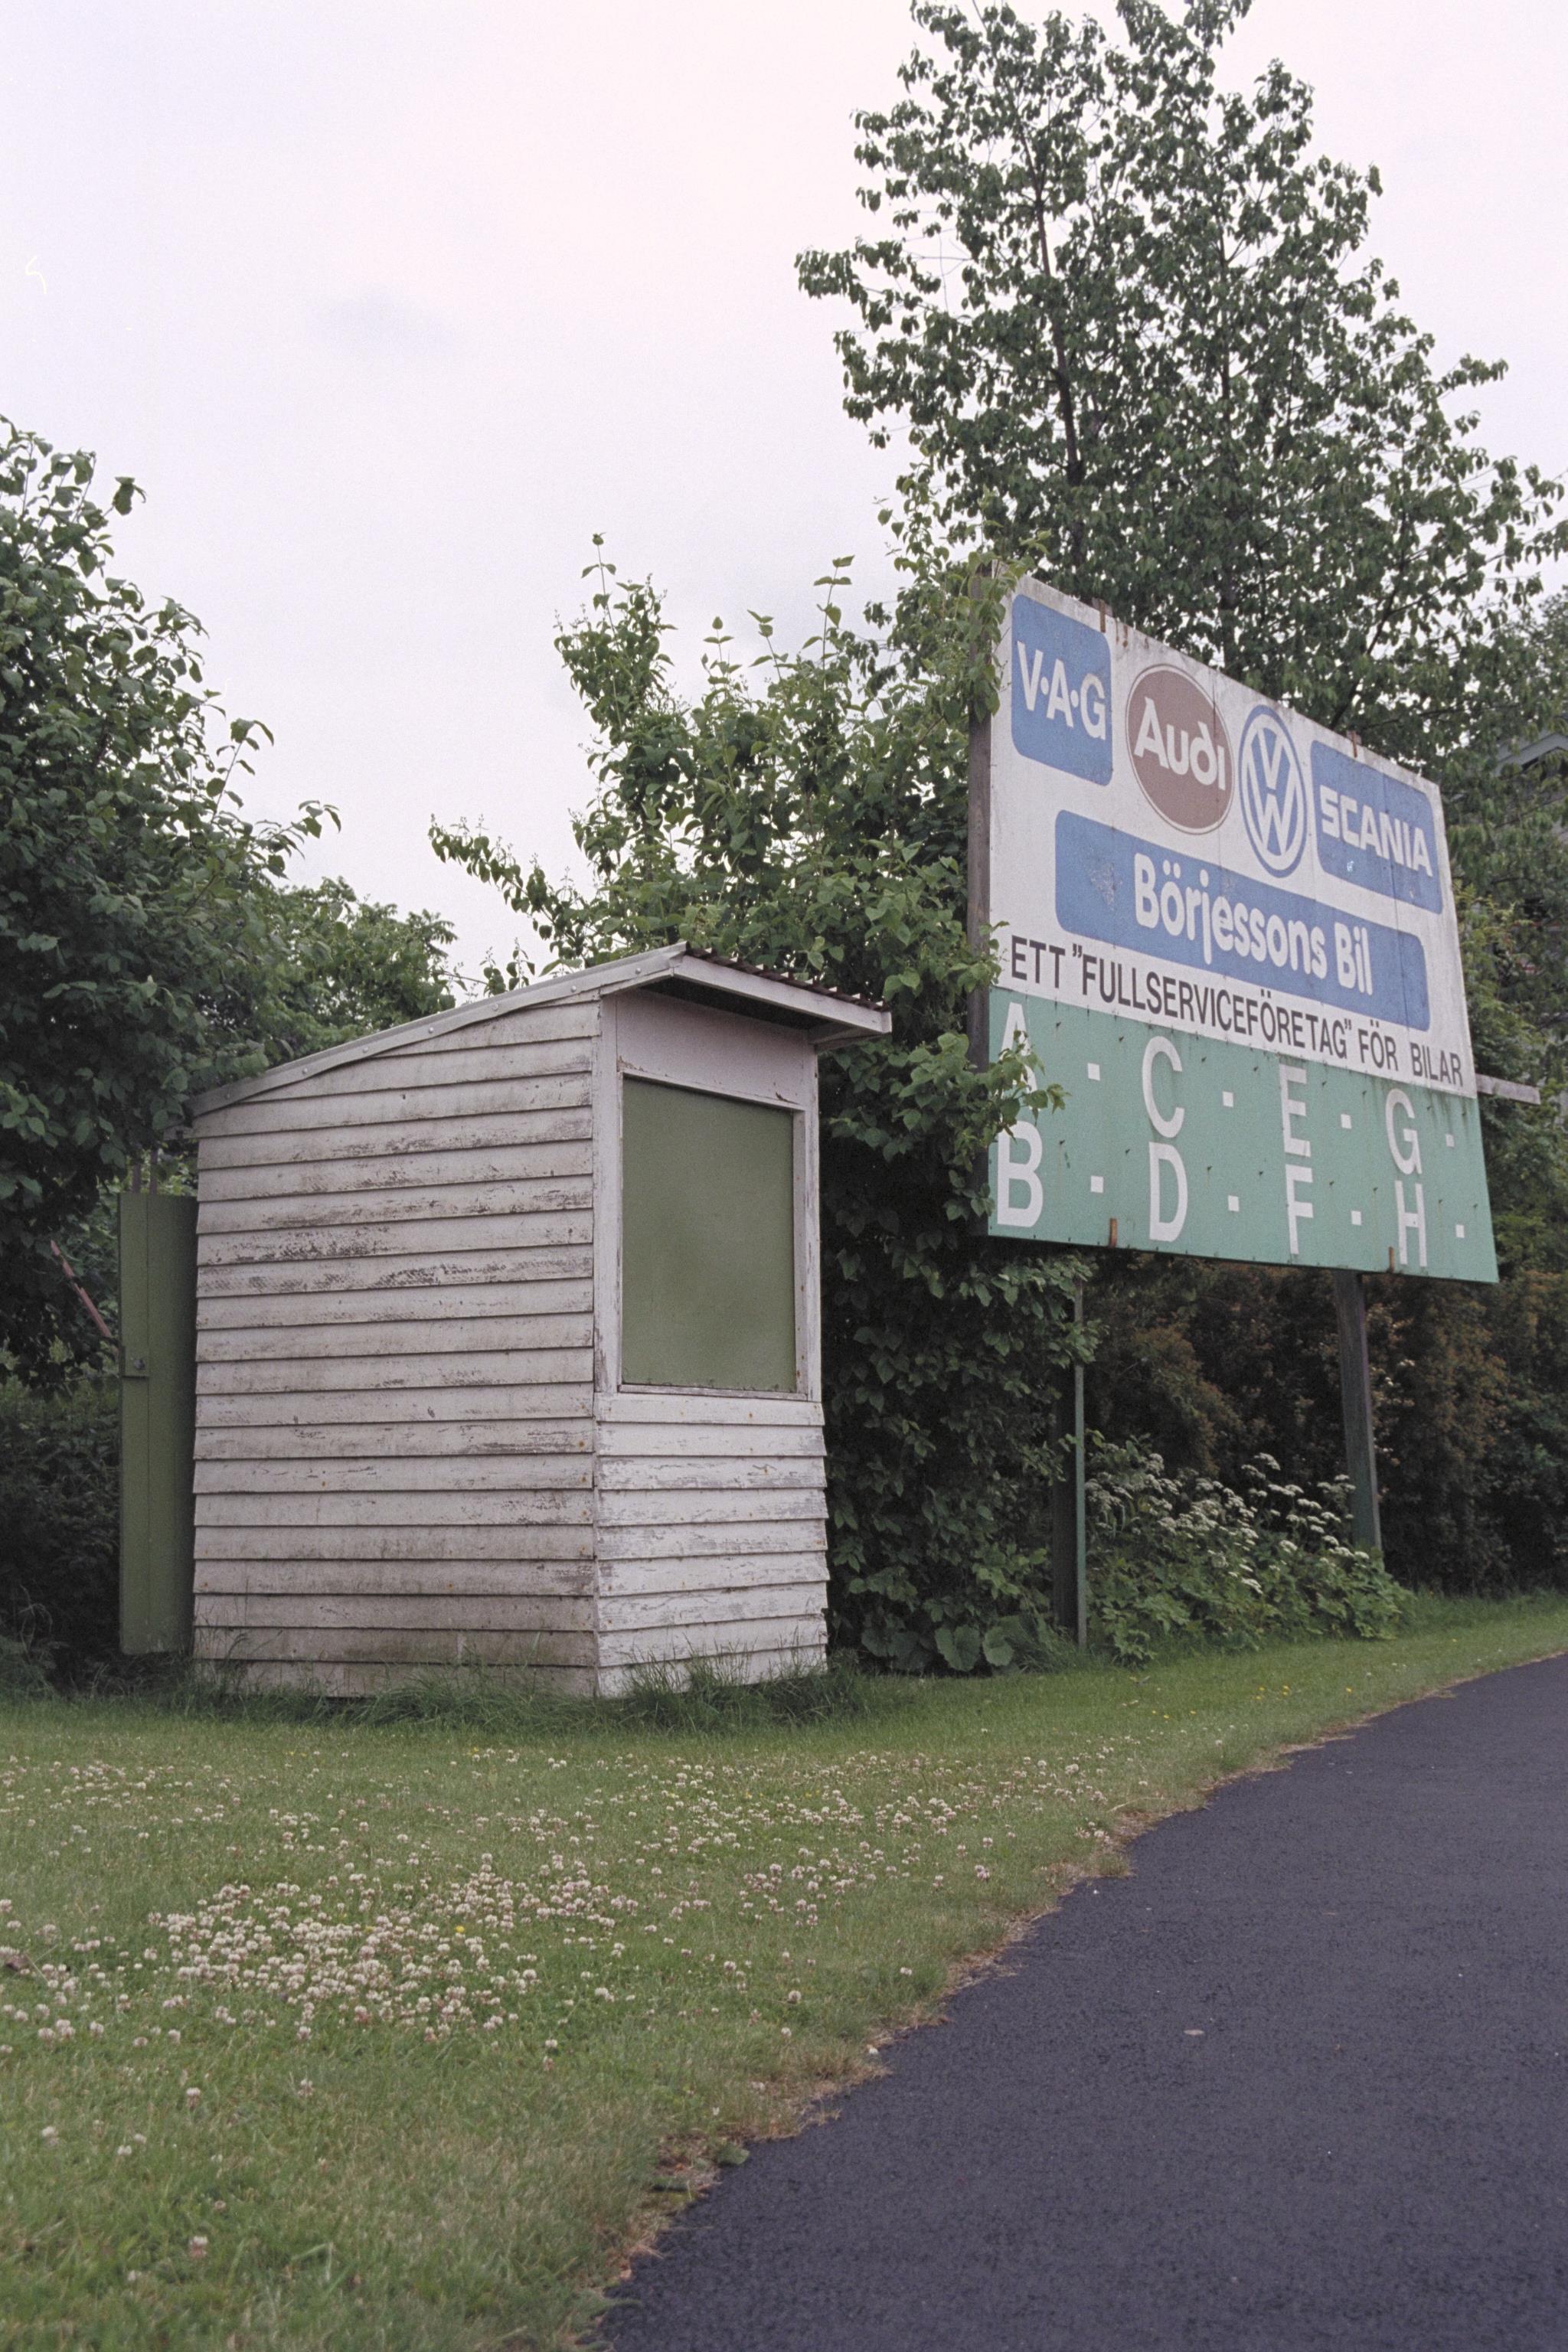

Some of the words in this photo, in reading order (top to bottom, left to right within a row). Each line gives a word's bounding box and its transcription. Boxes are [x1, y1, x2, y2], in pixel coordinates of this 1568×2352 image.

[1134, 696, 1226, 791] Audi
[1319, 784, 1433, 877] SCANIA
[1134, 852, 1328, 980] Börjessons
[1334, 922, 1374, 995] Bil
[1011, 934, 1066, 989] ETT
[1357, 1019, 1400, 1072] FÖR
[1410, 1041, 1464, 1087] BILAR
[1142, 1035, 1186, 1138] C
[1279, 1063, 1312, 1158] E
[1385, 1087, 1423, 1174] G
[997, 1120, 1044, 1228] B
[1148, 1141, 1189, 1243] D
[1285, 1163, 1314, 1255] F
[1394, 1179, 1428, 1268] H
